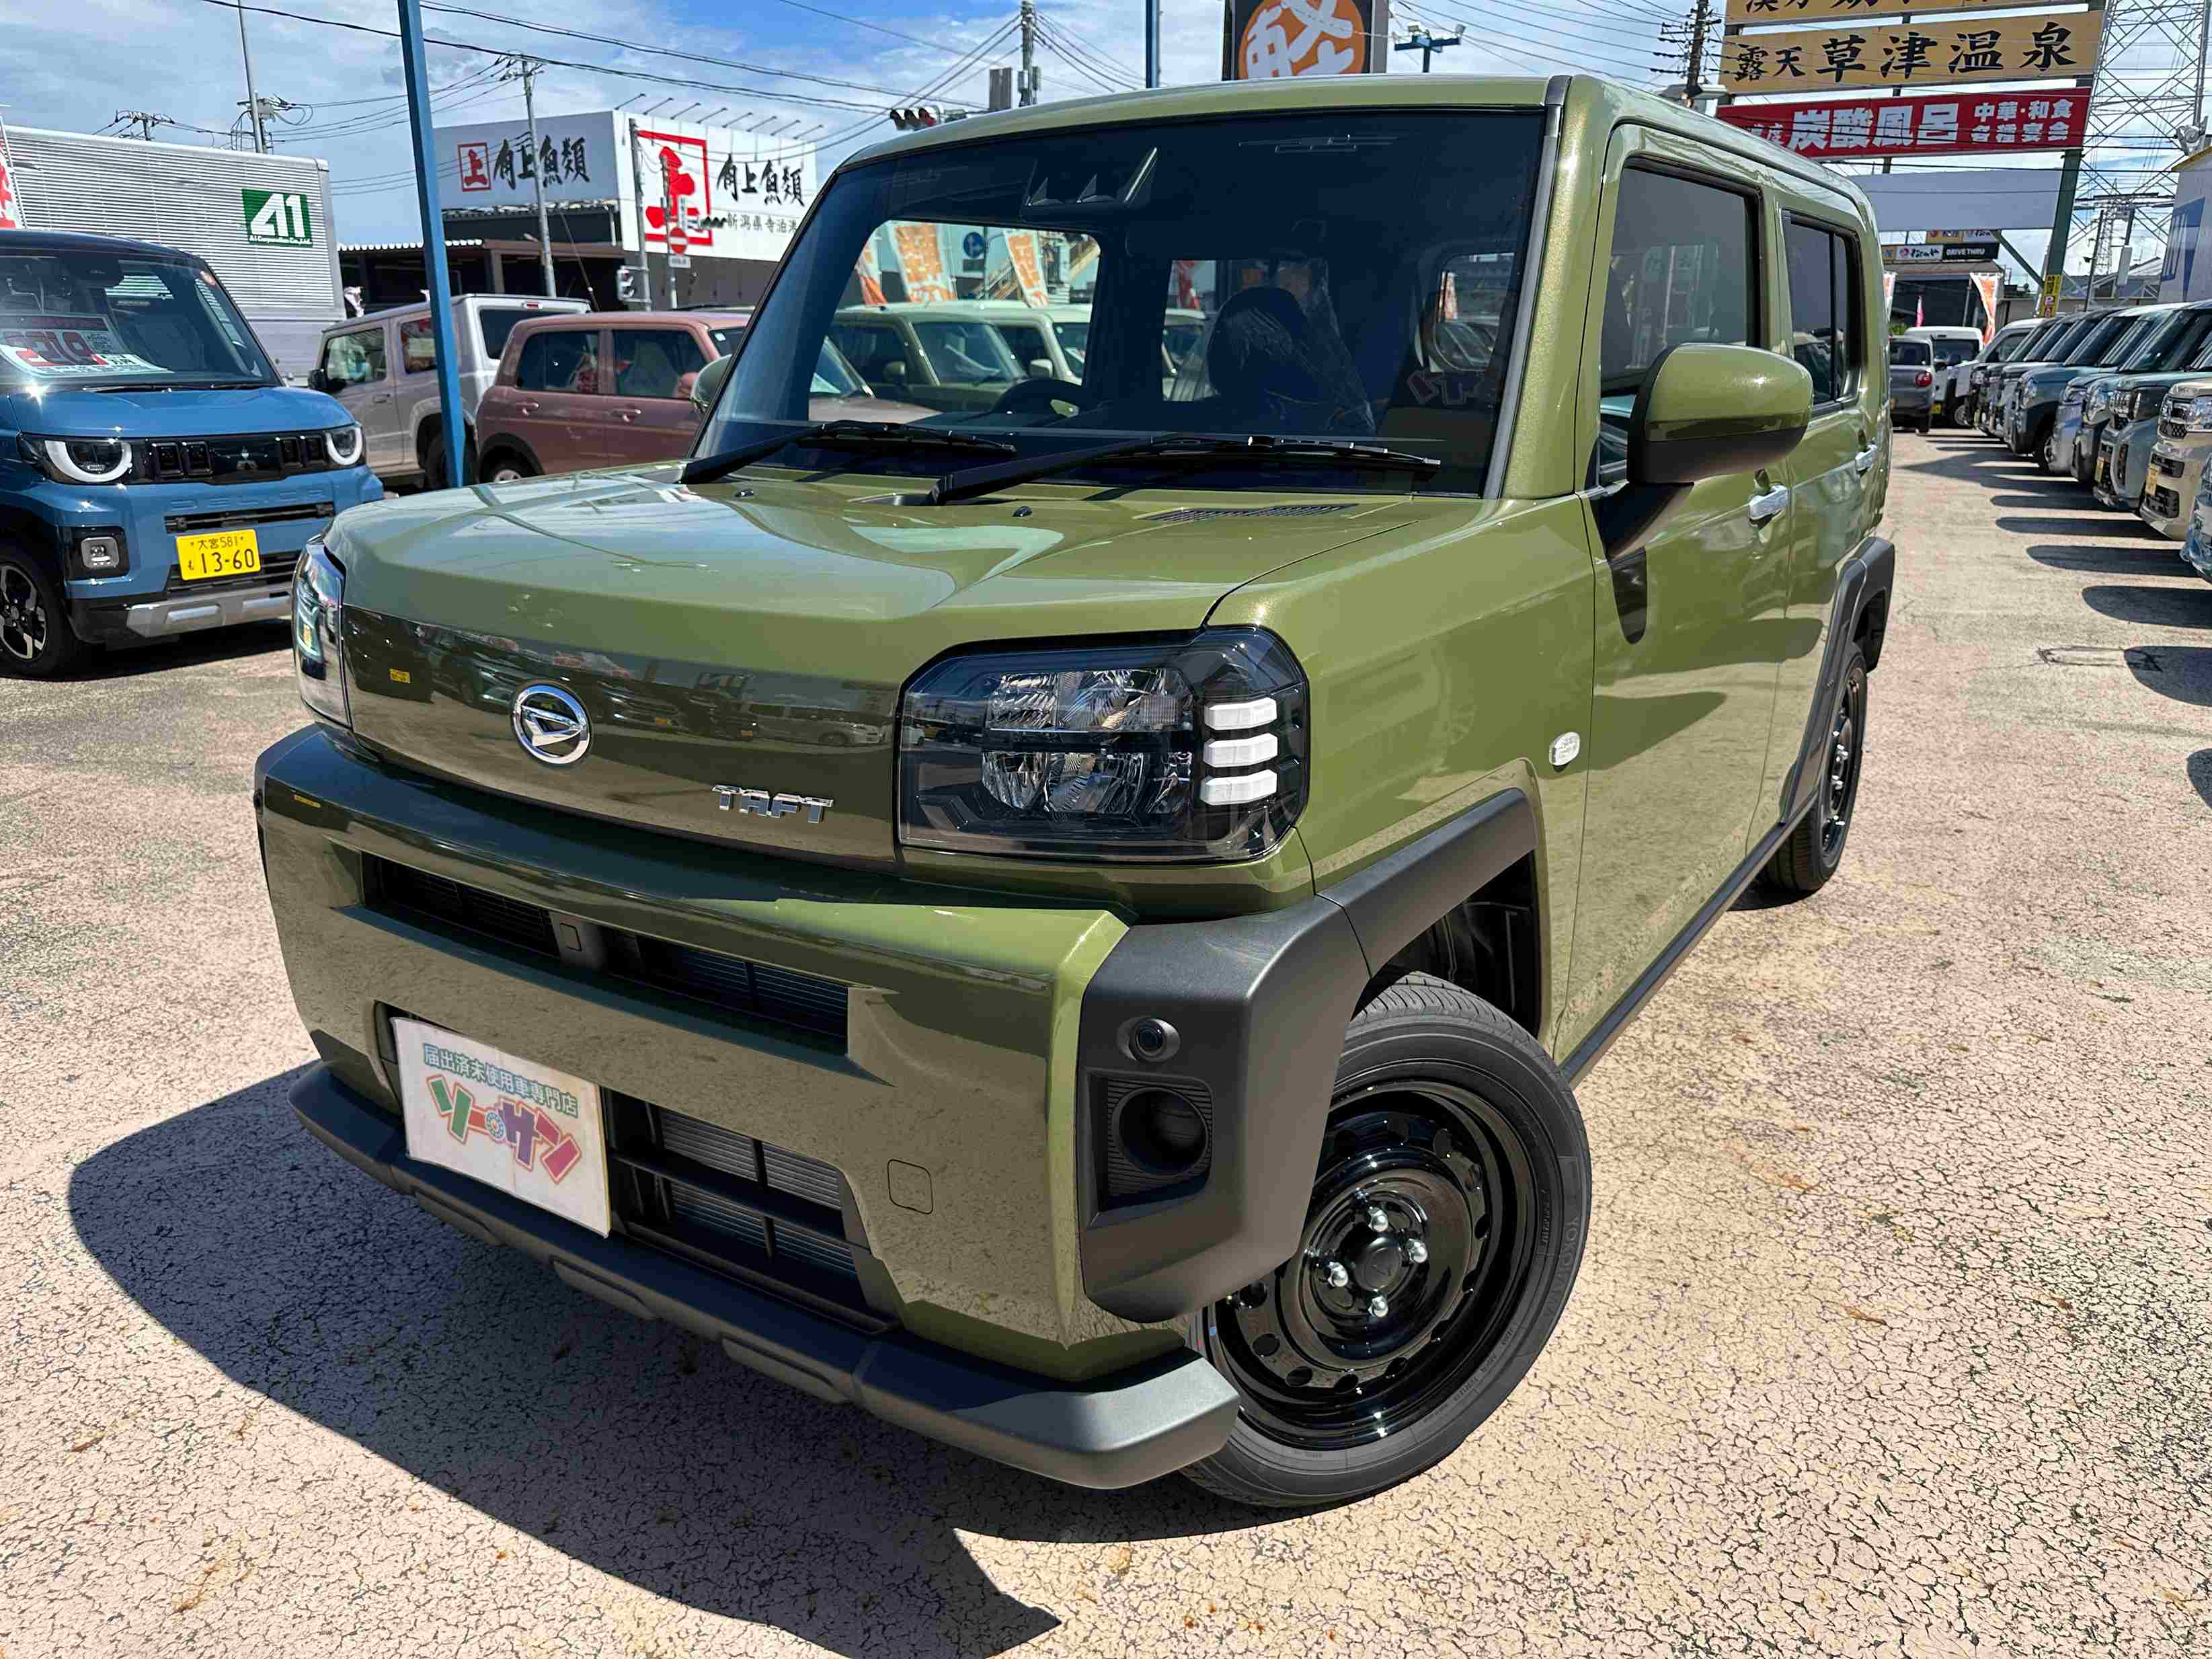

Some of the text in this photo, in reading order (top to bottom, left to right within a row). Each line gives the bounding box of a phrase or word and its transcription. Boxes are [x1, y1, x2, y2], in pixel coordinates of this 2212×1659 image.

[716, 153, 805, 207] 角上魚類
[201, 549, 255, 574] 13-60
[710, 784, 834, 824] TAFT
